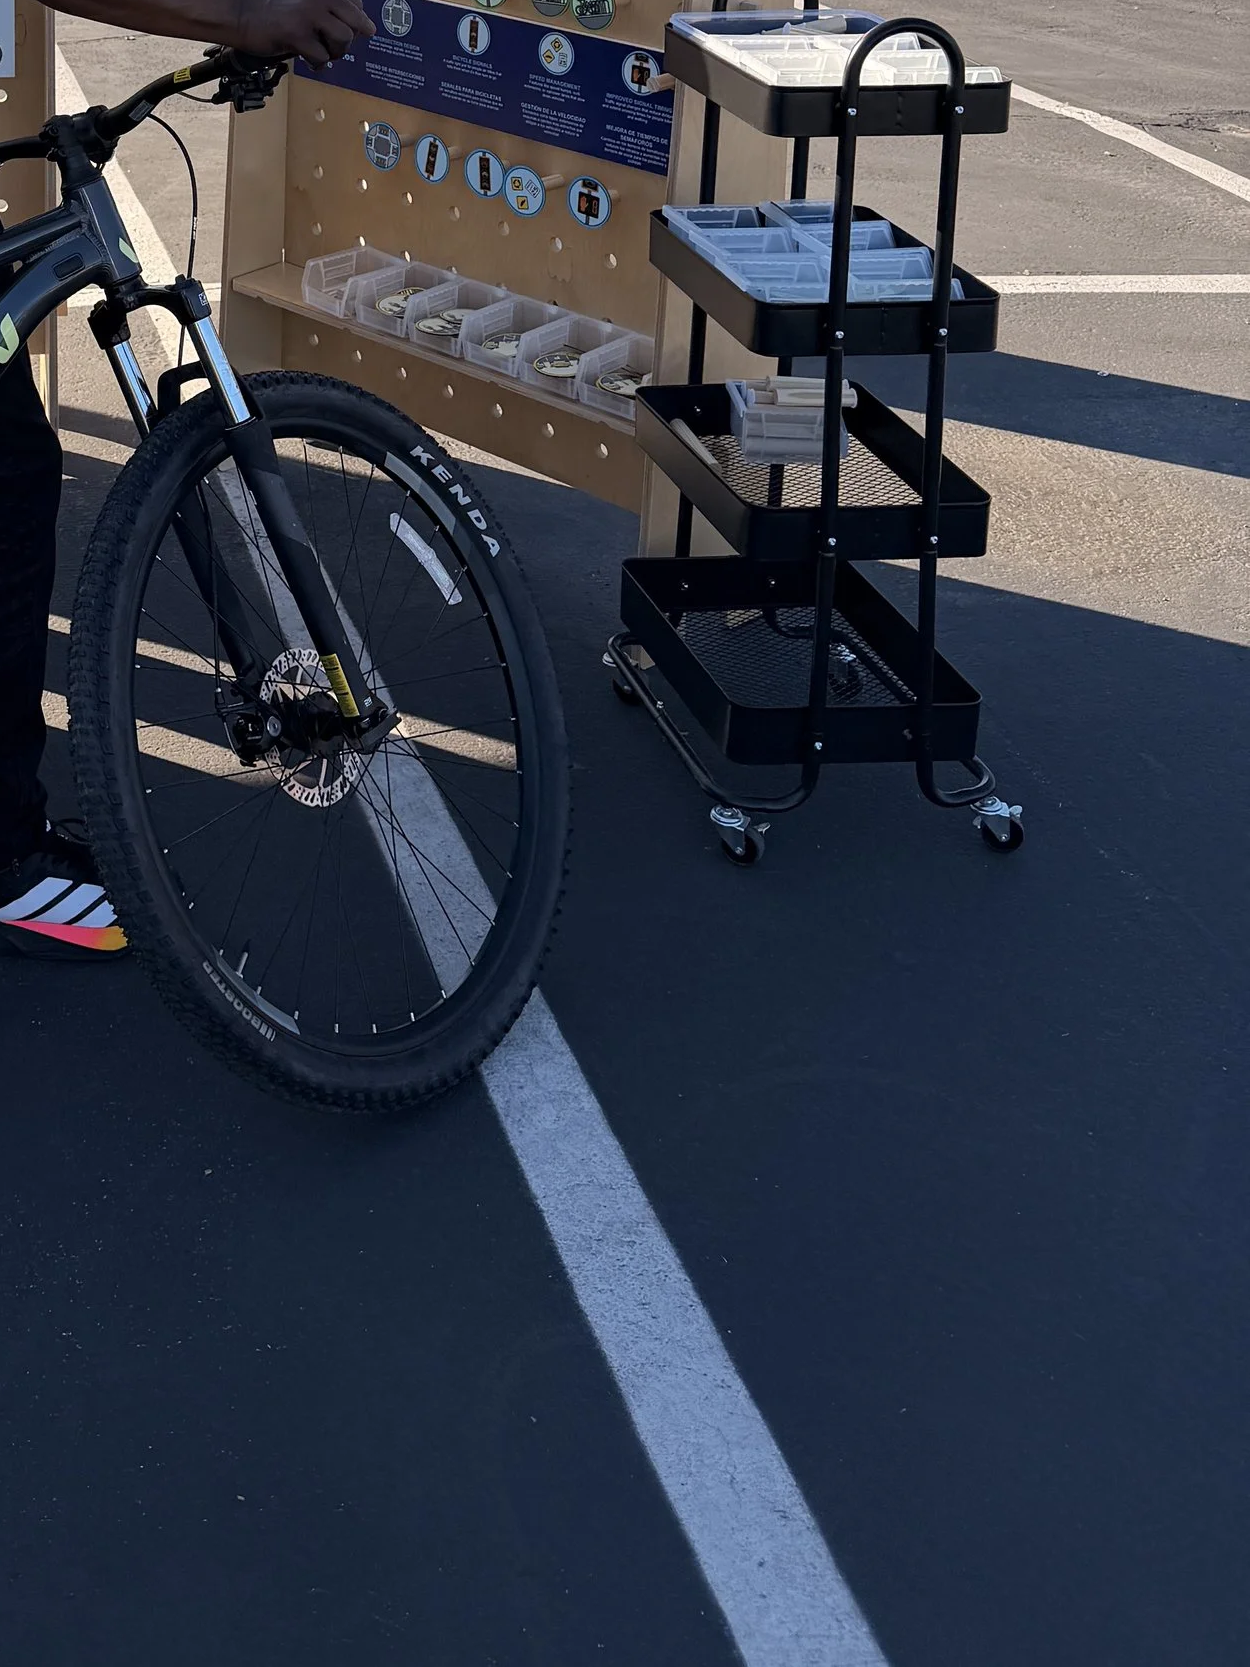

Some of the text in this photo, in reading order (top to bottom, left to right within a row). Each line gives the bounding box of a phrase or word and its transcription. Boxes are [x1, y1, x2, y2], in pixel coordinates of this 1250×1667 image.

[452, 54, 471, 65] BICYCLE
[529, 73, 546, 83] SPEED
[605, 92, 634, 104] IMPROVED
[541, 107, 550, 116] DE
[549, 109, 558, 117] LA
[557, 110, 587, 124] VELOCIDAD
[605, 124, 669, 146] MEJORA DE TIEMPOS DE
[409, 445, 501, 558] KENDA
[201, 959, 262, 1030] BOOSTER
